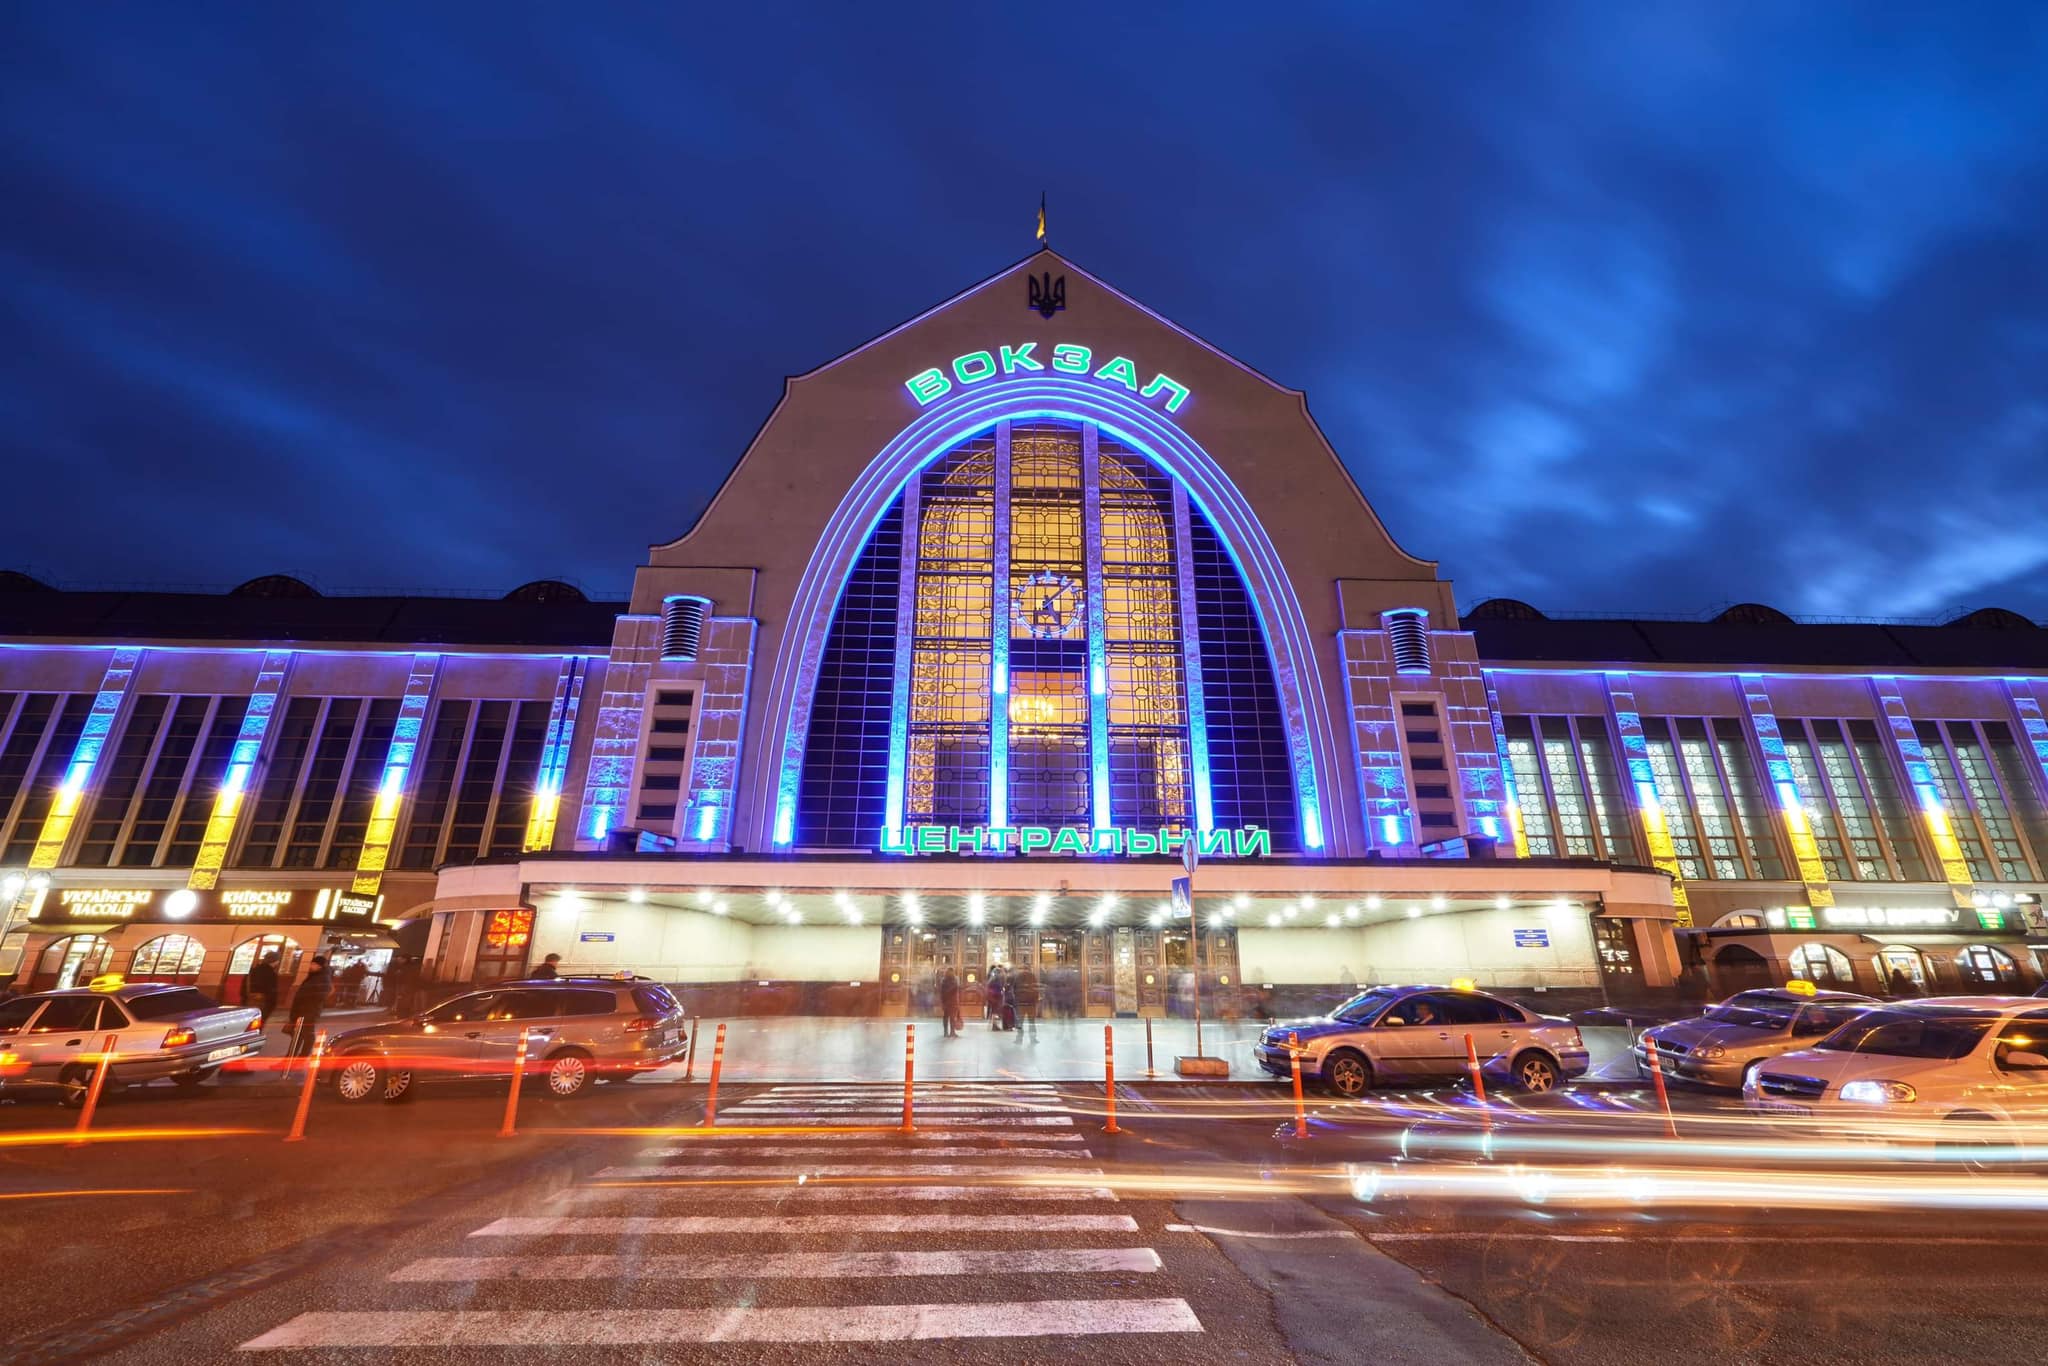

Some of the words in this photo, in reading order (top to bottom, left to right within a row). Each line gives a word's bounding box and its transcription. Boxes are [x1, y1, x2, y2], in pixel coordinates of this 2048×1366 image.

[905, 343, 1190, 413] ВОКЗАЛ
[879, 825, 1271, 855] ЦЕНТРАЛЬНИЙ
[61, 889, 152, 905] УКРАЇНСЬКІ
[222, 890, 292, 904] КИЇВСЬКІ
[229, 903, 277, 917] ТОРТИ
